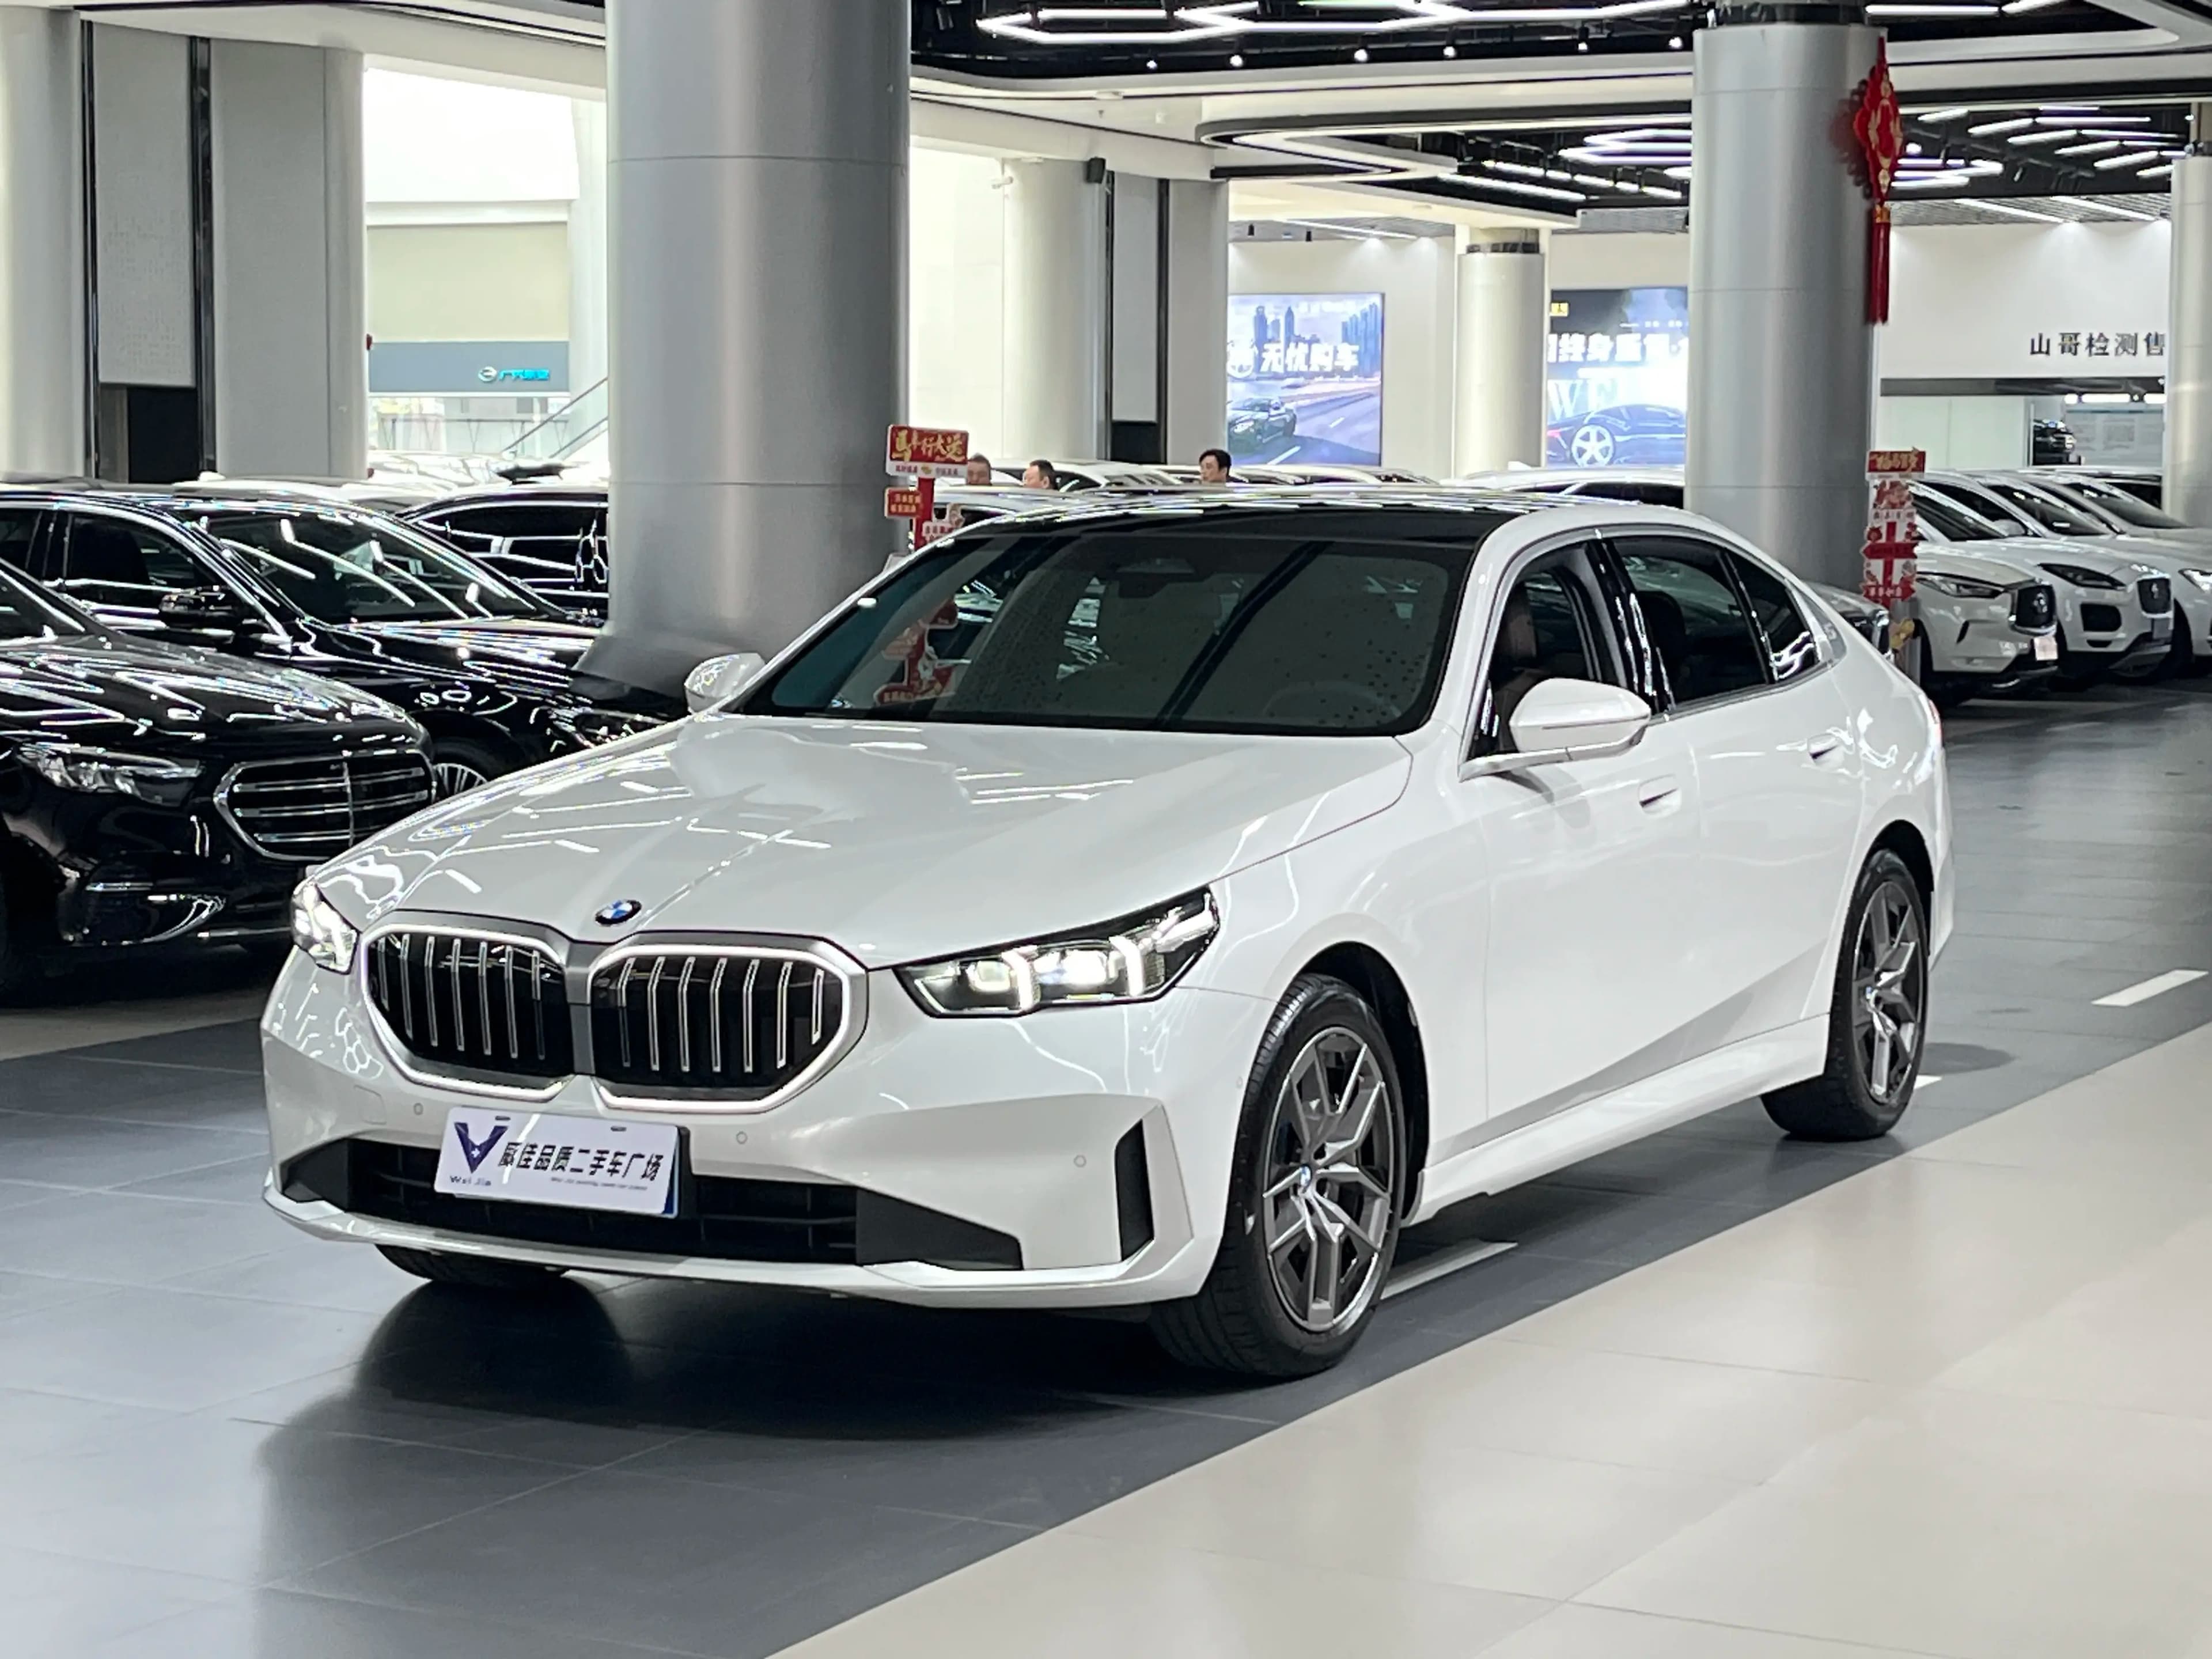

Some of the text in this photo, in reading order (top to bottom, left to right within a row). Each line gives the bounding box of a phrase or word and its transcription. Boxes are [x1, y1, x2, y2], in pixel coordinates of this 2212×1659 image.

[1260, 342, 1359, 373] 无忧购车
[2029, 332, 2165, 357] 山哥检测售
